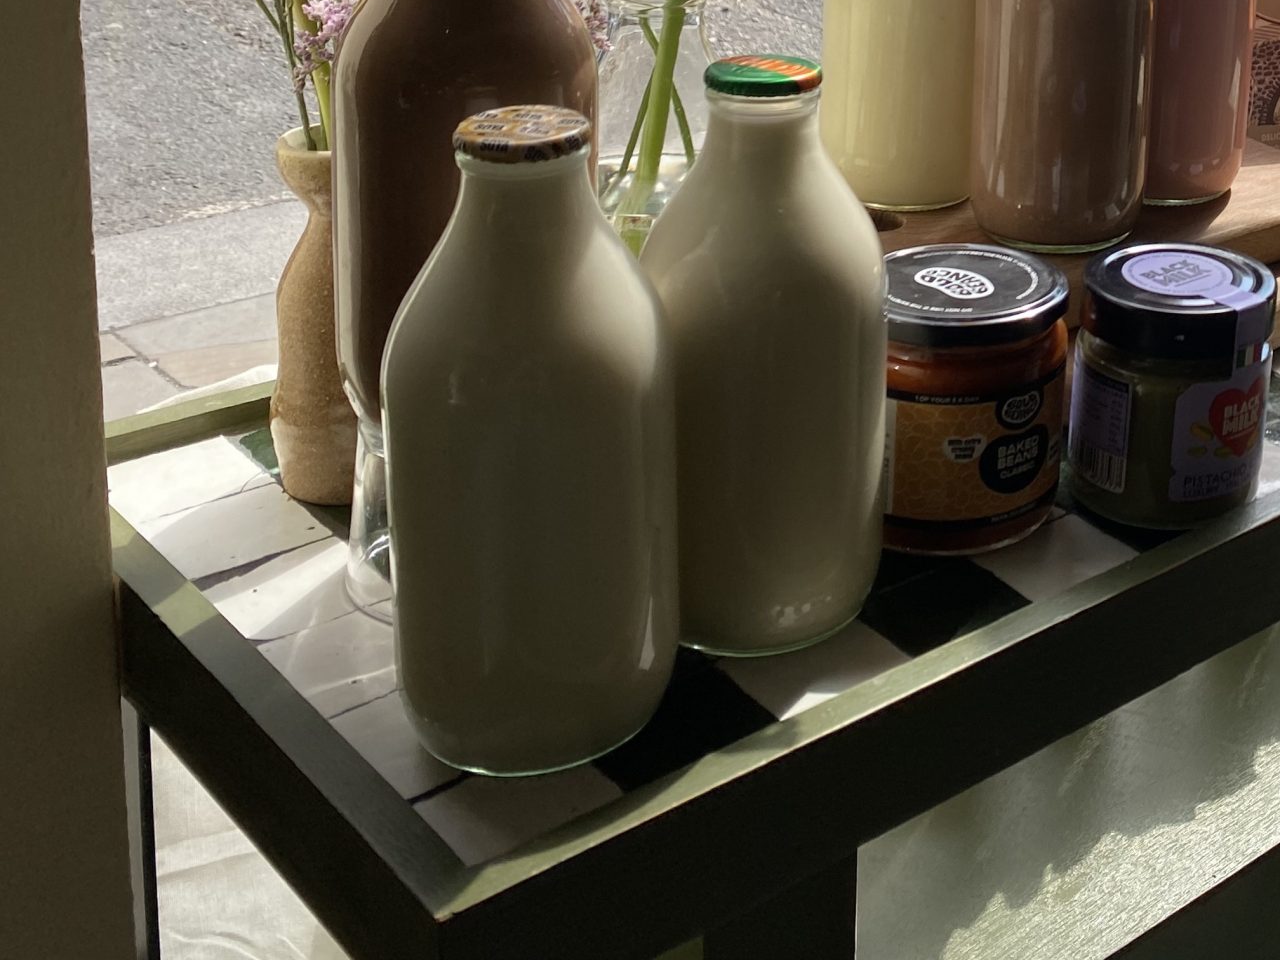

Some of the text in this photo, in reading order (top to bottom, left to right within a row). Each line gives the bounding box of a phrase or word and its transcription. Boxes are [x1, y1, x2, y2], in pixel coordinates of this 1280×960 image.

[1139, 259, 1195, 279] BLACK
[1152, 264, 1211, 287] MILK
[1224, 393, 1260, 419] BLACK
[1222, 410, 1259, 436] MILK
[997, 445, 1039, 469] BEANS
[998, 434, 1040, 457] BAKED
[1183, 463, 1247, 487] PISTACHIO
